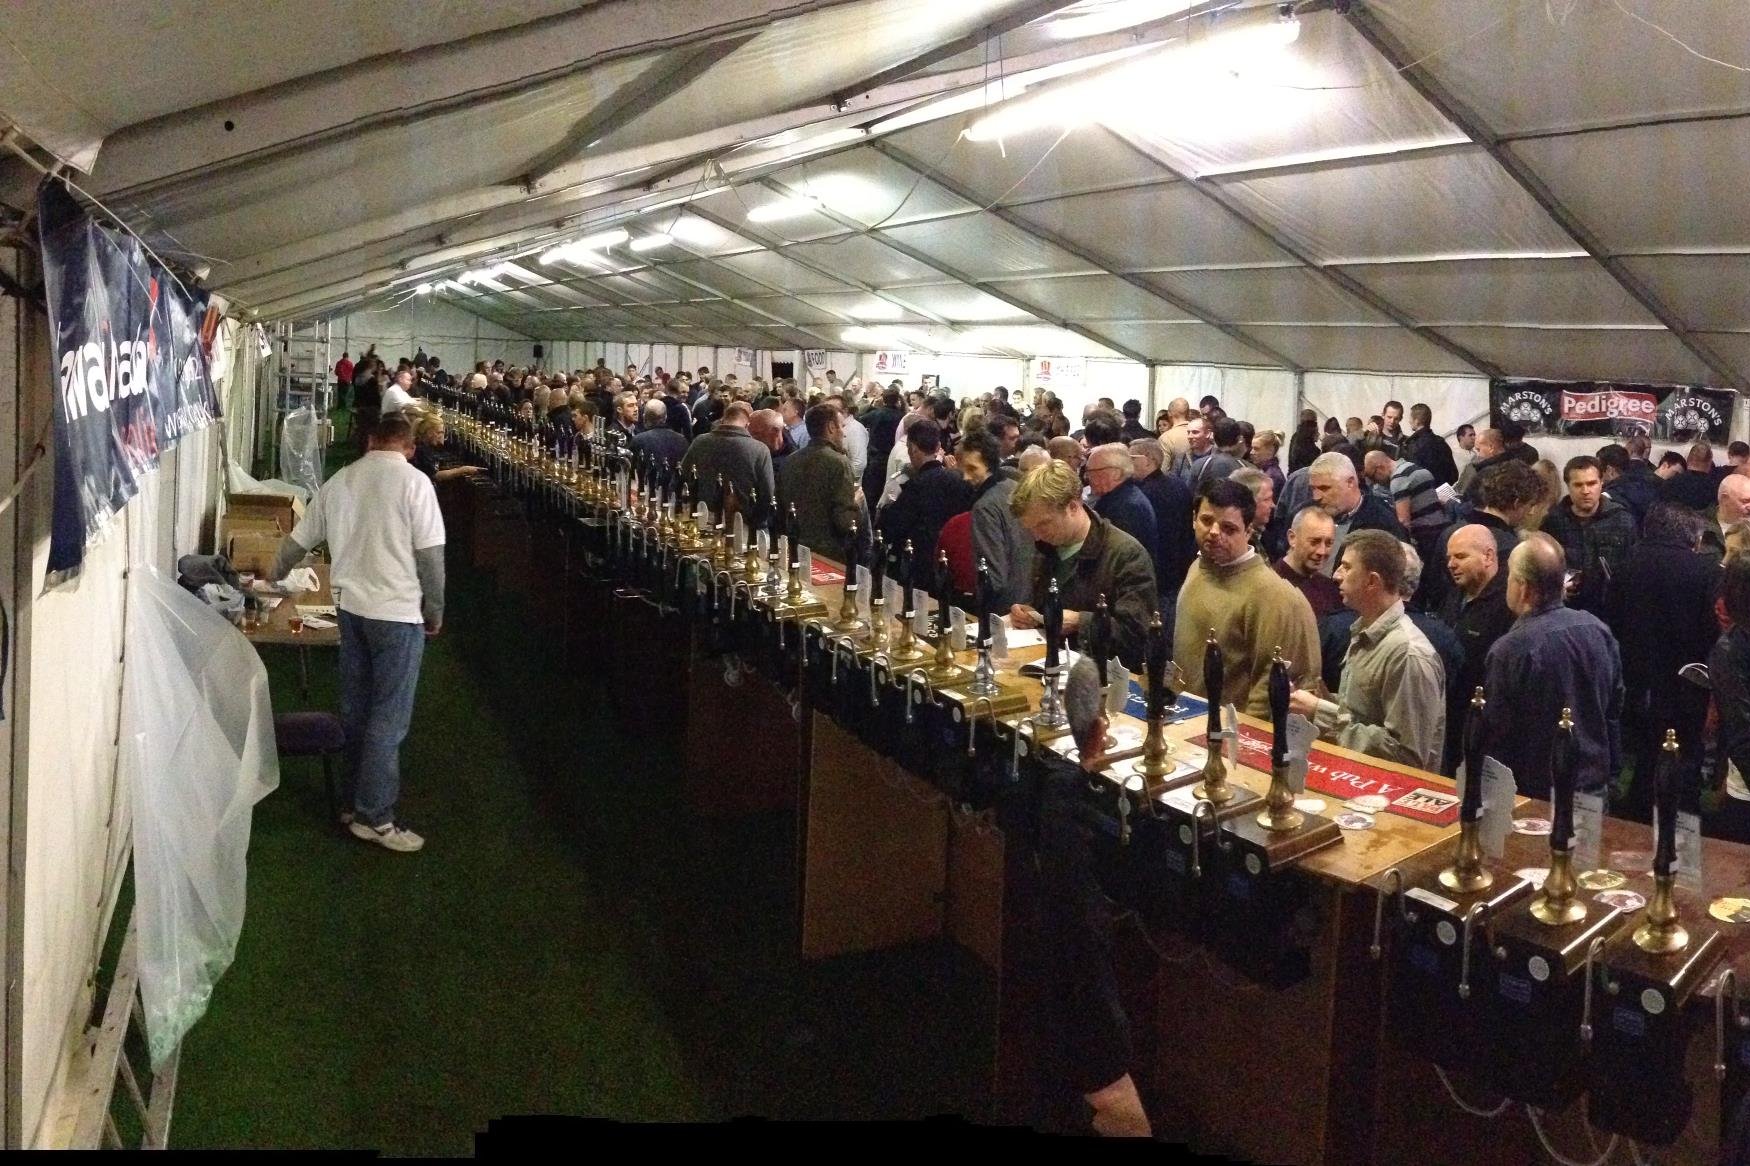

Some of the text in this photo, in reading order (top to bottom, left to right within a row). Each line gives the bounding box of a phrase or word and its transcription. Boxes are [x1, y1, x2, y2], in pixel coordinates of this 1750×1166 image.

[1500, 390, 1553, 416] MARSTON'S
[1563, 394, 1656, 418] Pedigree
[1664, 397, 1723, 427] MARSTON'S
